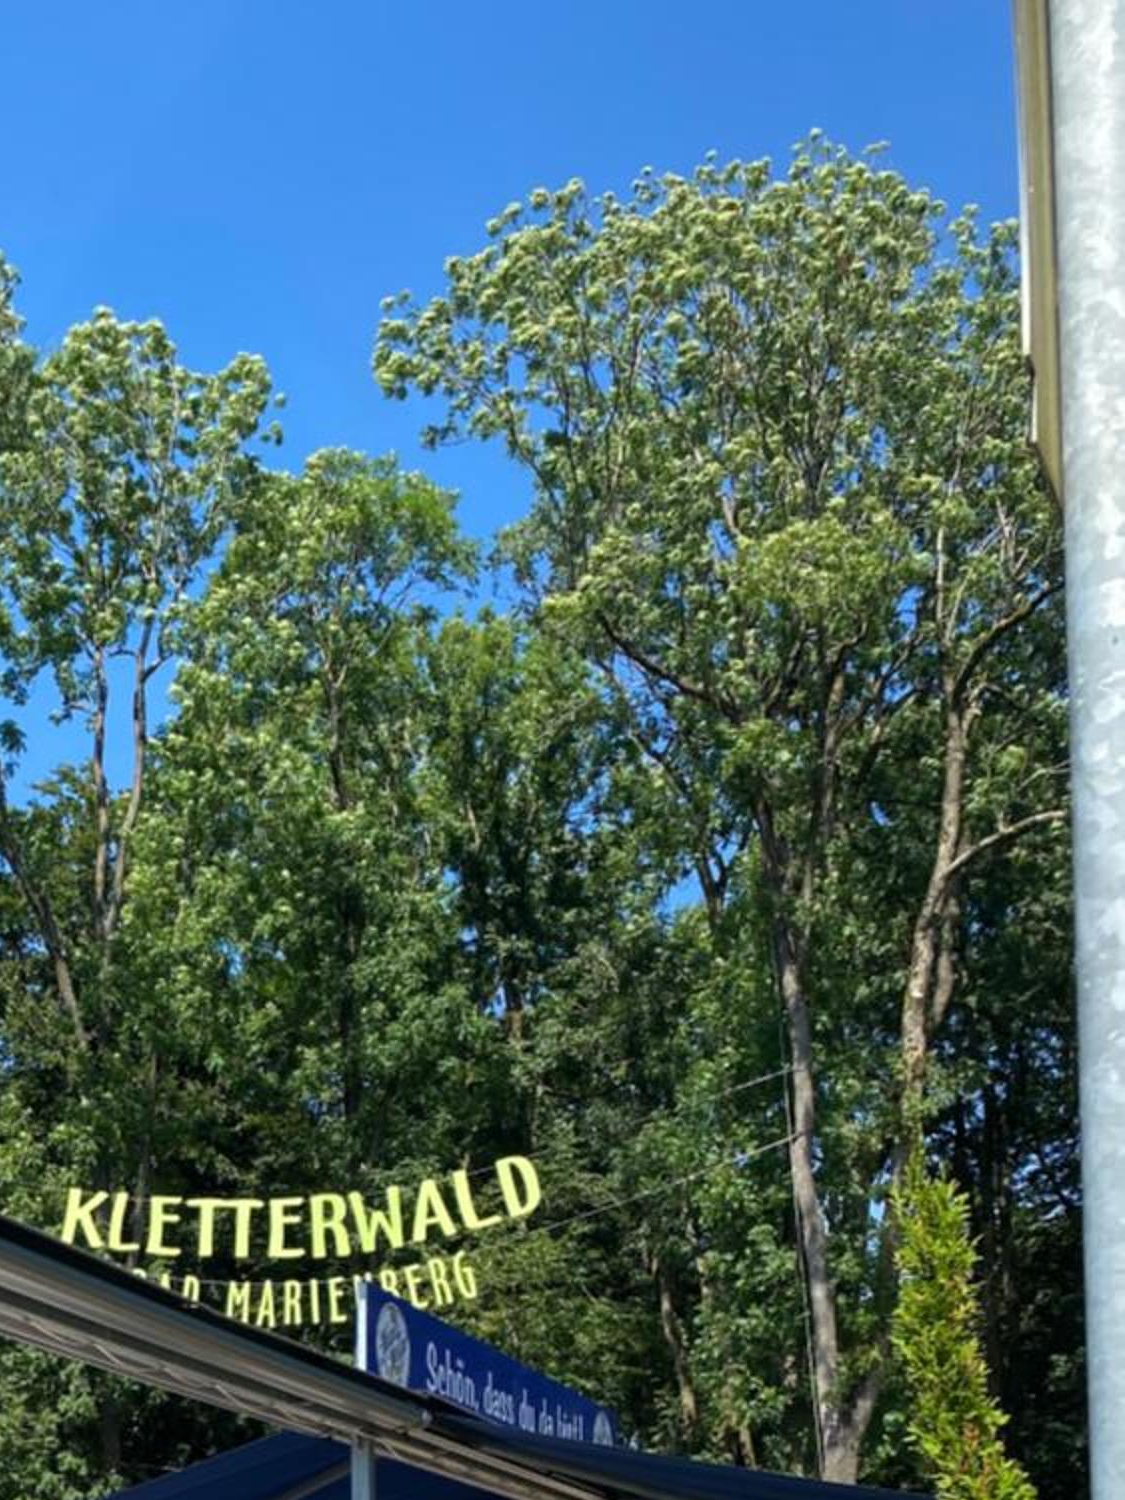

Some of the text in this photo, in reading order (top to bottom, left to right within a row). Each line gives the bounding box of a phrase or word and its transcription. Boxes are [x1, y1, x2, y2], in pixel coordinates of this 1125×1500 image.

[61, 1155, 541, 1259] KLETTERWALD
[226, 1251, 478, 1328] MARIEBERG
[426, 1341, 479, 1410] Schön,
[483, 1371, 515, 1424] dass
[519, 1388, 535, 1433] du
[538, 1398, 554, 1437] da
